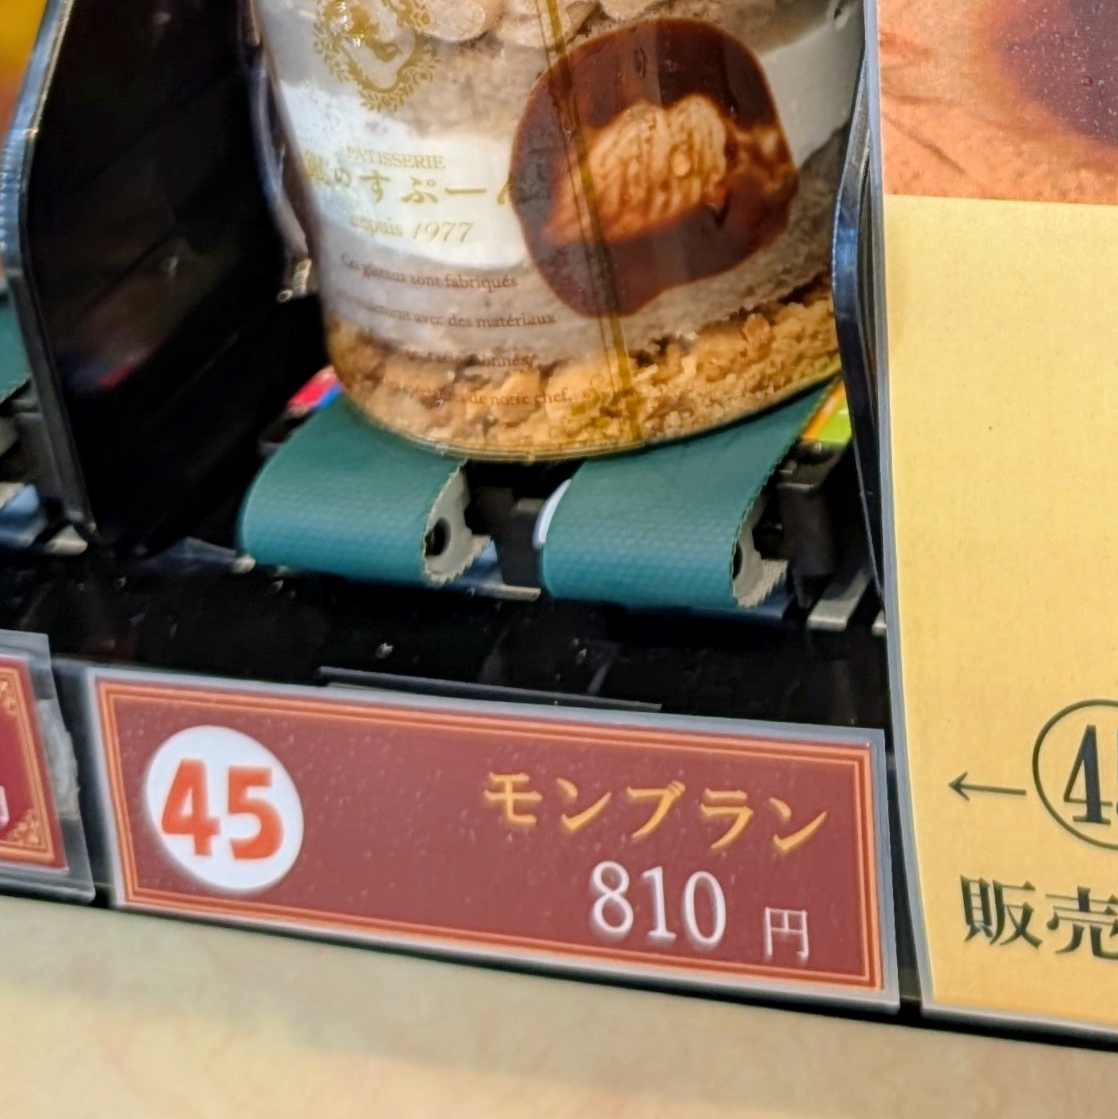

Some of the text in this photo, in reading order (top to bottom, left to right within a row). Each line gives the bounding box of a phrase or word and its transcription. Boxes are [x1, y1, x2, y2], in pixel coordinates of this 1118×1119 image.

[412, 221, 475, 243] 1977
[160, 759, 284, 863] 45
[483, 770, 830, 857] モンブラン
[591, 860, 810, 962] 810 円
